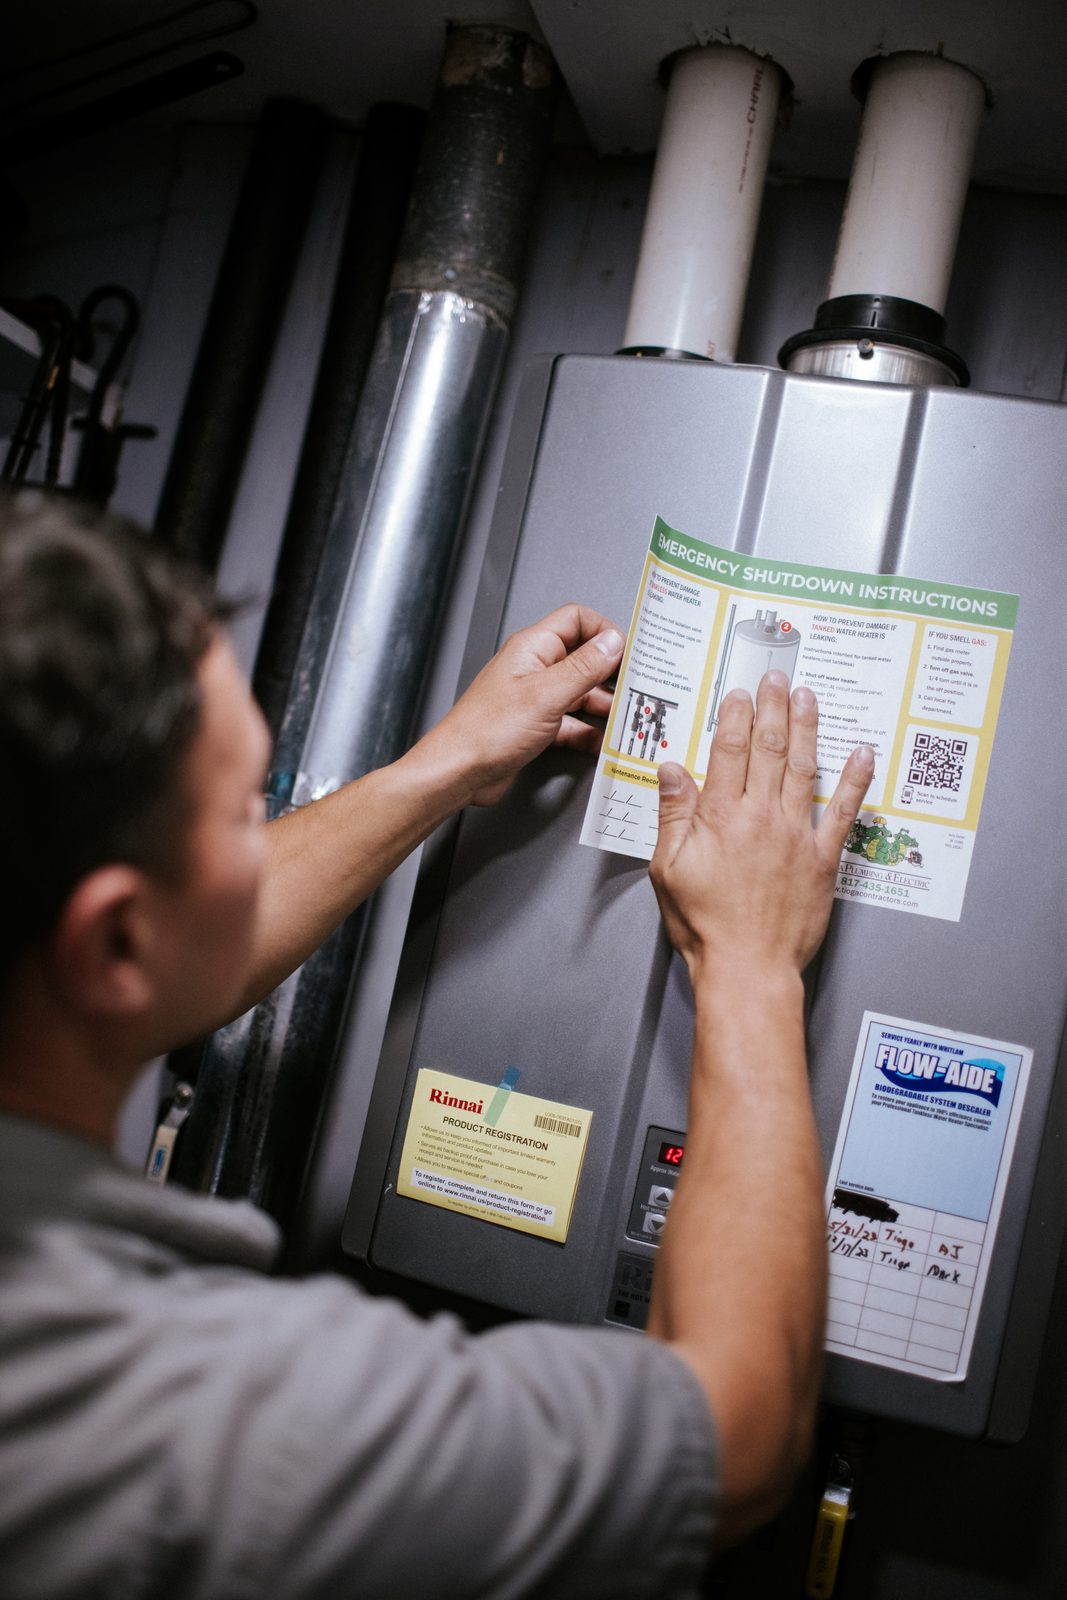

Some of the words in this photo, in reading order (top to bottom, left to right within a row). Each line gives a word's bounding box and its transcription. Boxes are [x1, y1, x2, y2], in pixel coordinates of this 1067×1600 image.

[658, 532, 740, 577] EMERGENCY
[742, 566, 853, 596] SHUTDOWN
[858, 583, 998, 617] INSTRUCTIONS
[661, 577, 680, 589] PREVENT
[680, 584, 700, 596] DAMAGE
[668, 590, 683, 600] WATER
[683, 596, 702, 607] HEATER
[811, 624, 836, 633] TANKED
[836, 628, 857, 636] WATER
[858, 631, 879, 640] HEATER
[813, 615, 828, 623] HOW
[838, 618, 865, 628] PREVENT
[866, 621, 891, 631] DAMAGE
[810, 633, 838, 643] LEAKING:
[950, 635, 971, 643] SMELL
[972, 638, 987, 646] GAS:
[804, 646, 833, 655] Instructions
[641, 775, 659, 785] Recor
[840, 876, 910, 898] 817-435-1651
[881, 1032, 904, 1042] SERVICE
[904, 1037, 922, 1046] YEARLY
[923, 1041, 938, 1050] WITH
[938, 1045, 965, 1056] WHITLAM
[875, 1043, 996, 1094] FLOW-AIDE
[430, 1088, 484, 1114] Rinnai
[874, 1083, 930, 1102] BIODEGRADABLE
[930, 1096, 957, 1109] SYSTEM
[957, 1103, 992, 1117] DESCALER
[878, 1095, 895, 1103] restore
[907, 1102, 930, 1111] appliance
[974, 1117, 993, 1125] contact
[882, 1102, 912, 1113] Professional
[912, 1109, 934, 1118] Tankless
[442, 1116, 483, 1134] PRODUCT
[484, 1127, 549, 1151] REGISTRATION
[457, 1142, 474, 1151] product
[460, 1152, 473, 1160] proof
[423, 1173, 448, 1186] register,
[447, 1181, 475, 1194] complete
[488, 1192, 507, 1202] return
[508, 1197, 520, 1205] this
[520, 1201, 536, 1210] form
[504, 1182, 523, 1191] coupons
[418, 1179, 437, 1190] online
[444, 1188, 547, 1222] www.rinnai.us/product-registration
